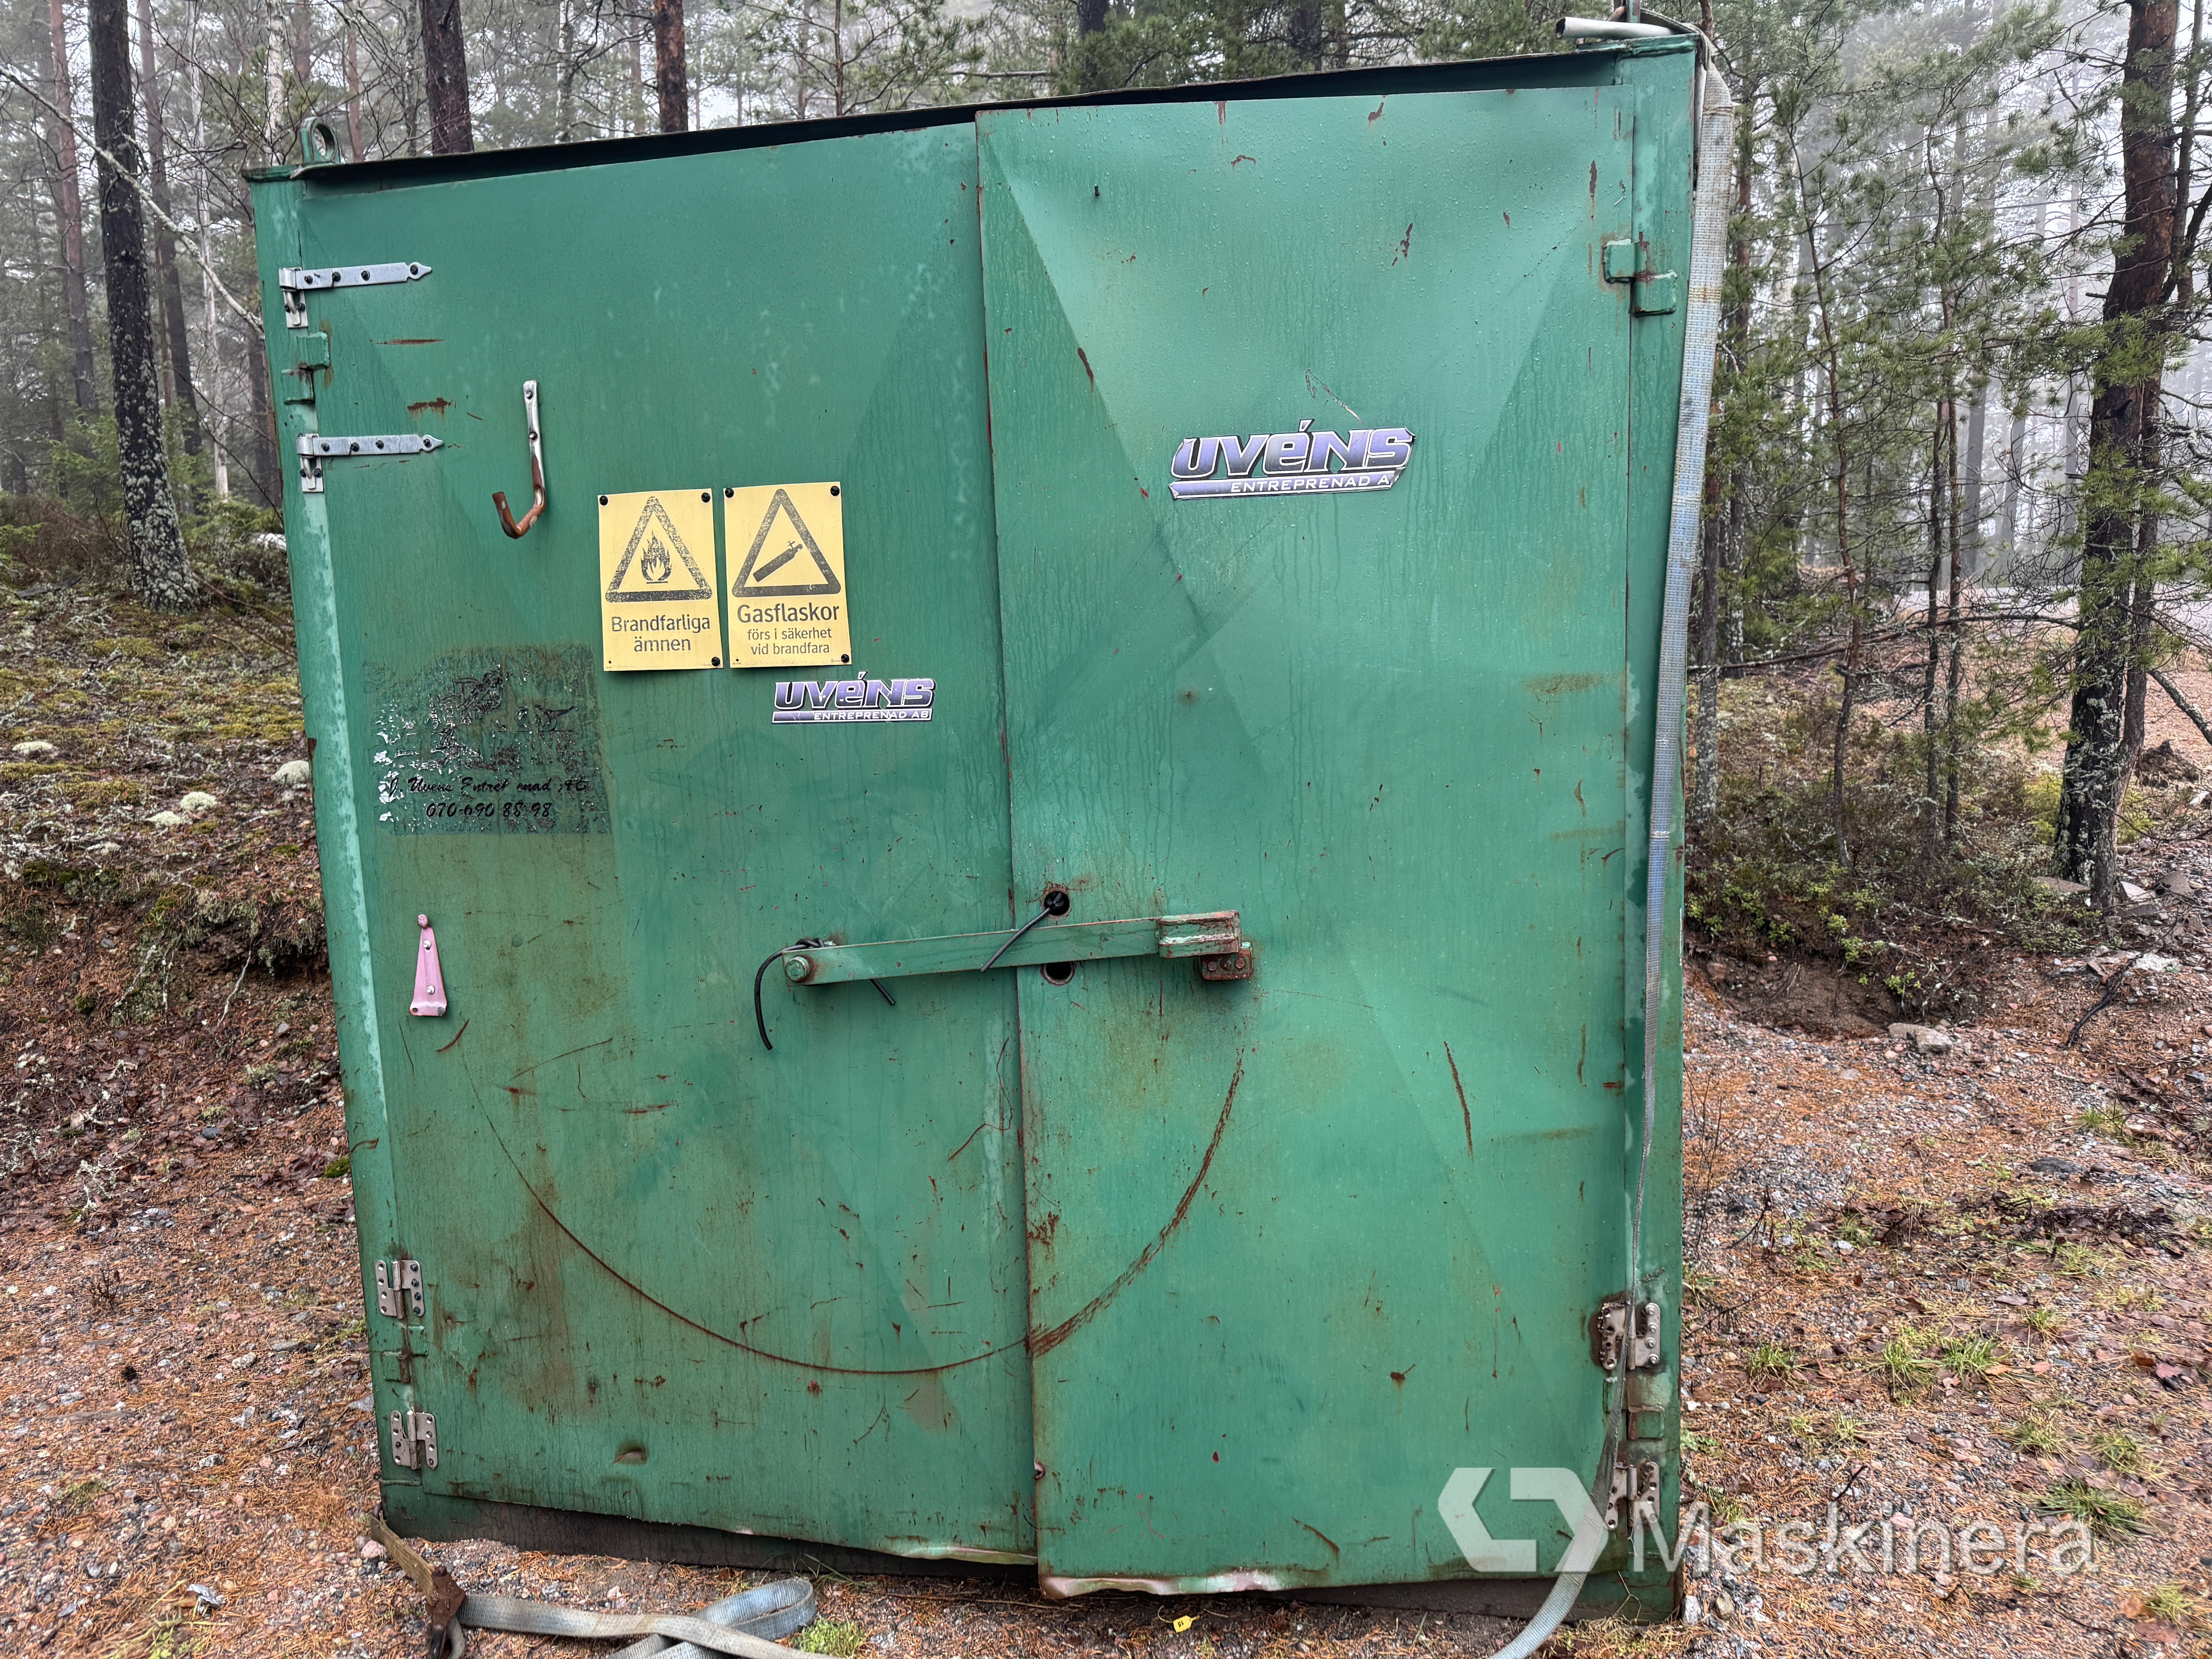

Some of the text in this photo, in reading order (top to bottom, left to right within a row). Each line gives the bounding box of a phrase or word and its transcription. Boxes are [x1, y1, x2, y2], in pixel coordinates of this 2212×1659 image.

[1230, 474, 1396, 493] ENTREPRENAD A
[737, 602, 839, 623] Gasflaskor
[611, 614, 710, 633] Brandfarliga
[747, 627, 832, 640] förs i säkerhet
[634, 636, 691, 652] ämnen
[751, 642, 830, 654] vid brandfara
[814, 711, 907, 720] ENTREPRENAD
[426, 802, 495, 817] 070-690
[532, 802, 552, 817] 98
